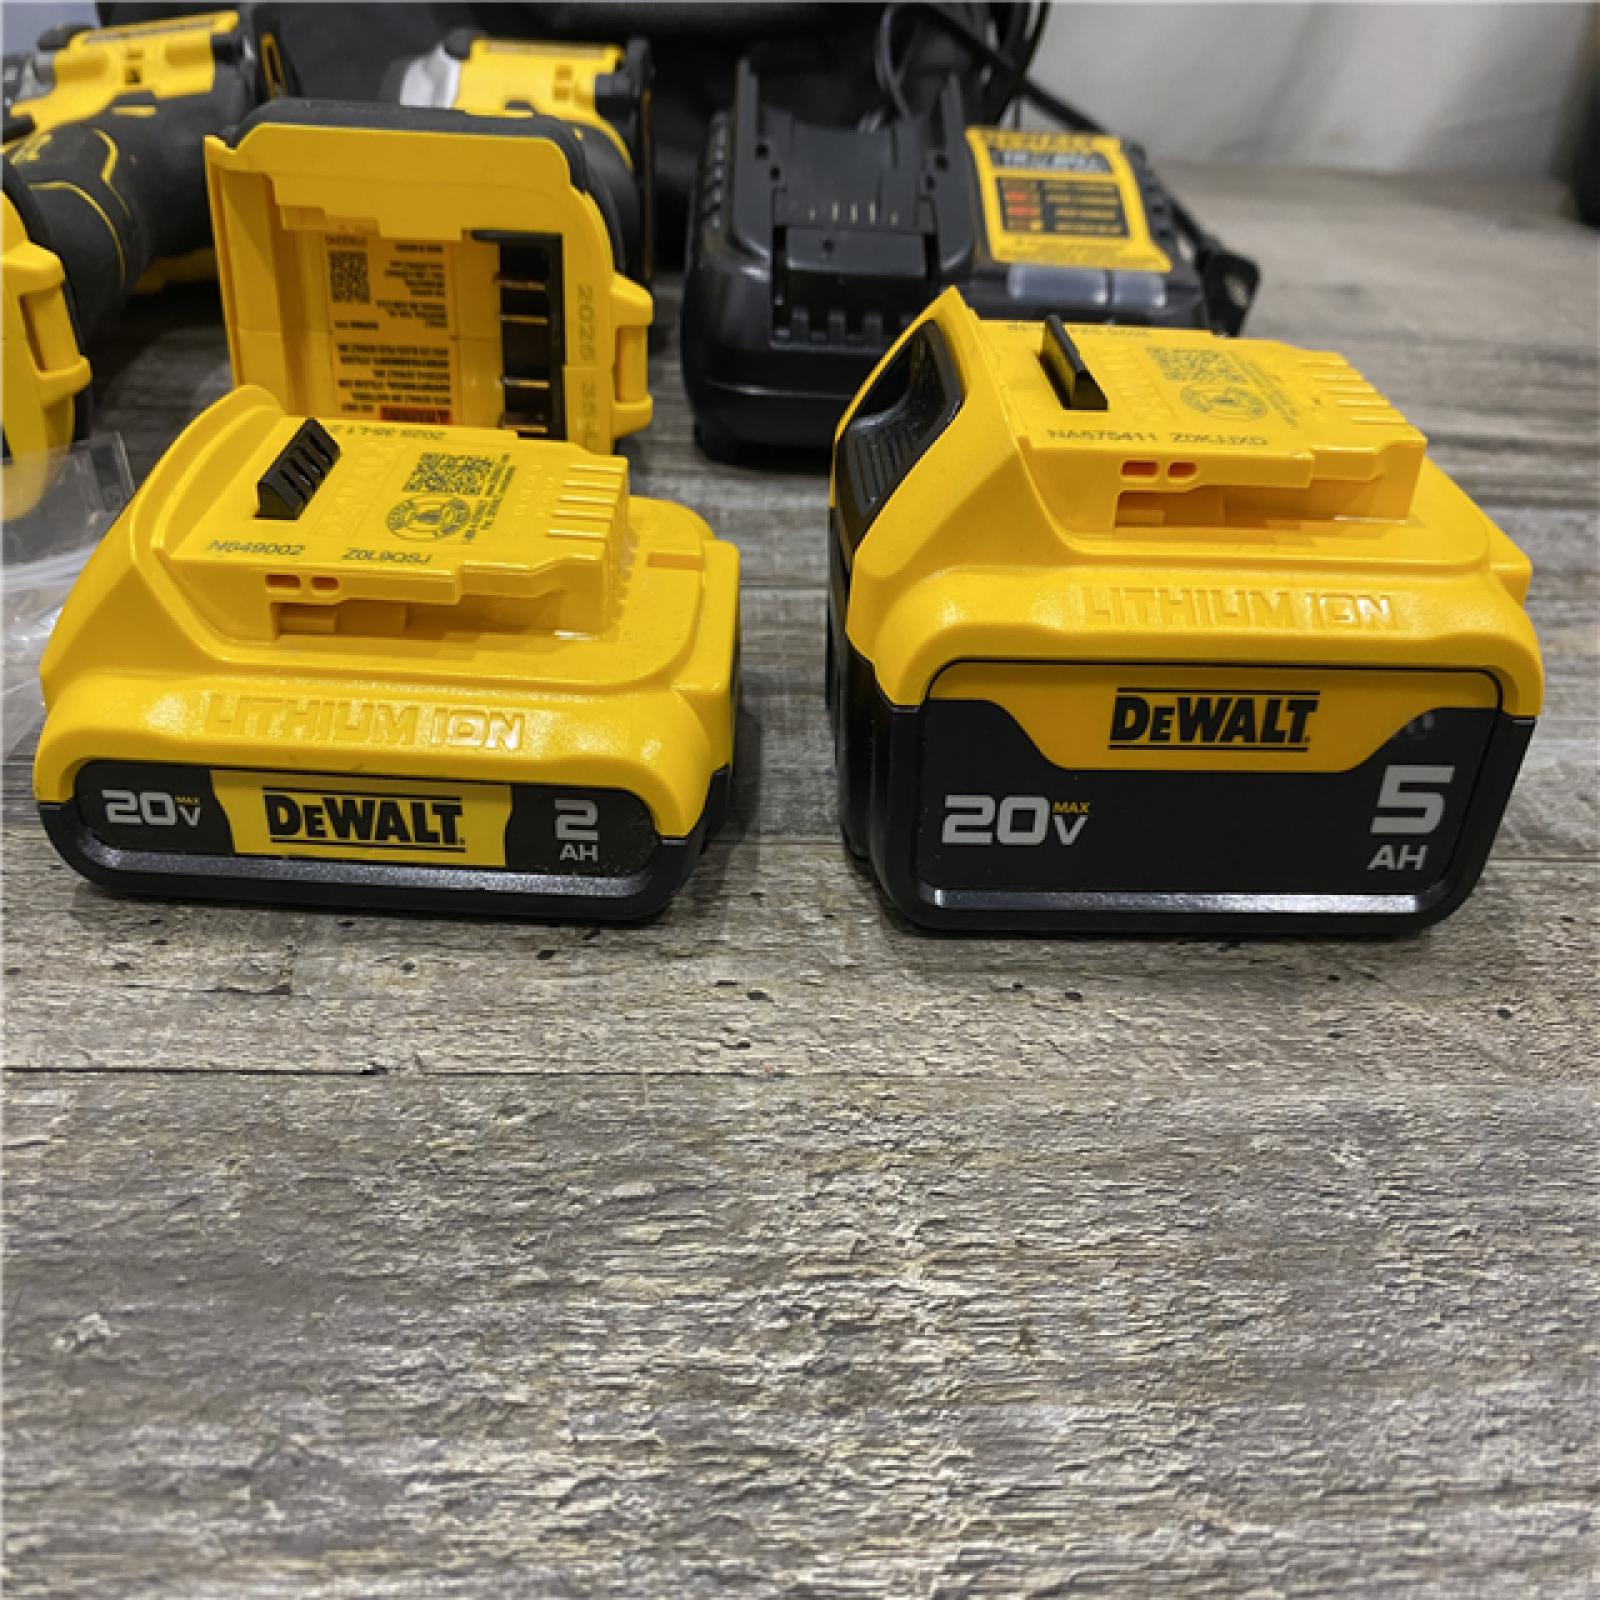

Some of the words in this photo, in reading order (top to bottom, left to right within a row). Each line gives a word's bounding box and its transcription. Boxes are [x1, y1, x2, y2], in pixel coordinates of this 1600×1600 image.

[1081, 587, 1292, 632] LITHIUM
[1304, 591, 1399, 633] ION
[204, 694, 418, 746] LITHIUM
[431, 706, 526, 750] ION
[555, 799, 598, 841] 2
[1052, 802, 1090, 814] MAX
[1370, 765, 1455, 834] 5
[560, 843, 598, 862] AH
[1367, 844, 1429, 871] AH
